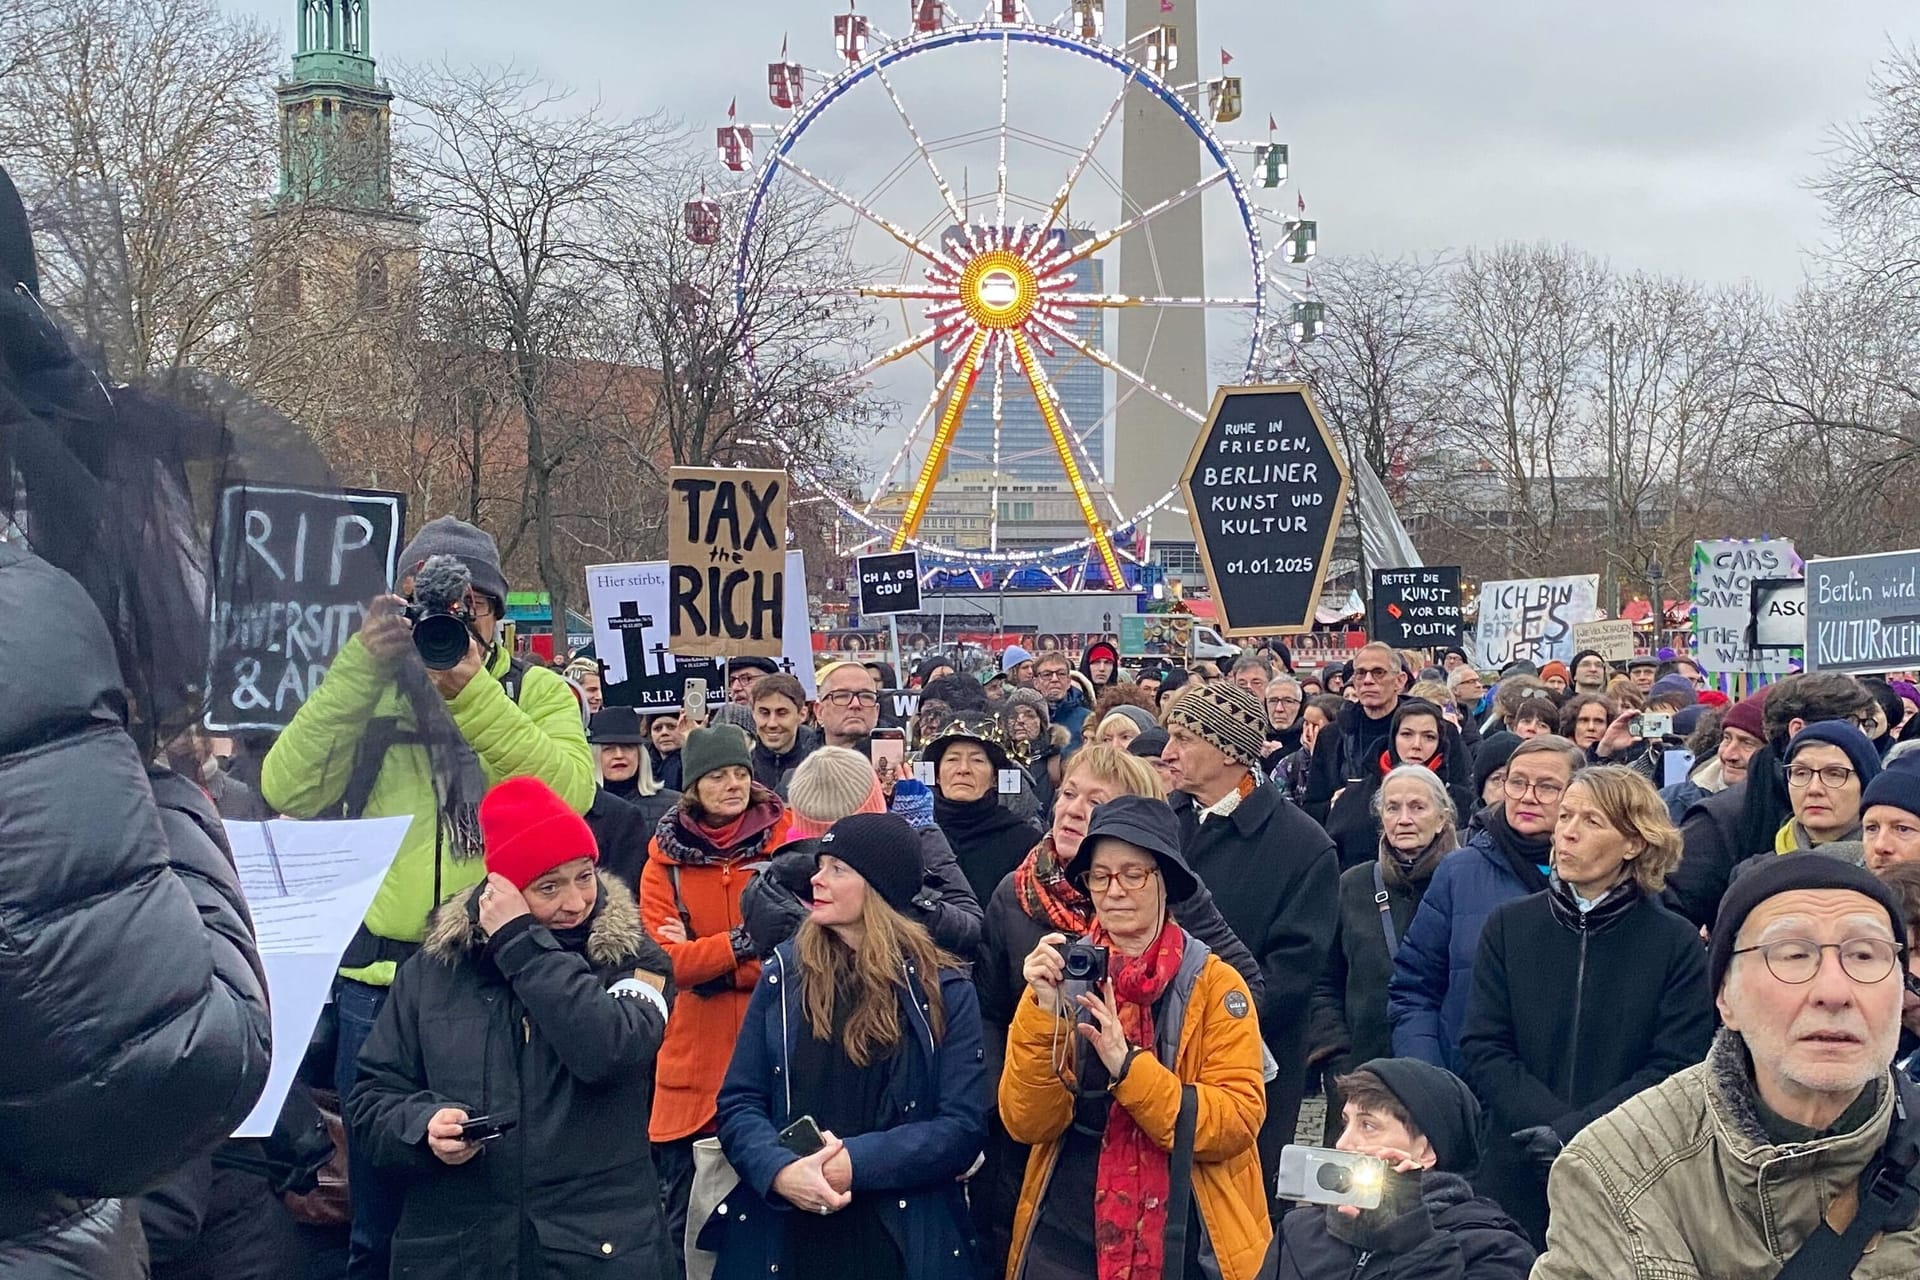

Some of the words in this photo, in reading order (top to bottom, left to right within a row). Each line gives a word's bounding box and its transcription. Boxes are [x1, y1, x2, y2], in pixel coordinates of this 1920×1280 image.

[1225, 423, 1256, 435] RUHE
[1268, 420, 1283, 433] IN
[1220, 437, 1311, 453] FRIEDEN,
[1203, 463, 1318, 486] BERLINER
[1211, 494, 1279, 512] KUNST
[1291, 493, 1323, 507] UND
[672, 479, 779, 551] TAX
[1221, 516, 1308, 535] KULTUR
[709, 546, 744, 565] the
[1713, 549, 1779, 570] CARS
[1227, 557, 1313, 574] 01.01.2025
[597, 576, 625, 588] Hier
[628, 573, 665, 587] stirbt,
[876, 583, 902, 595] CDU
[1381, 574, 1416, 585] RETTET
[1423, 574, 1439, 583] DIE
[1819, 570, 1873, 604] Berlin
[1882, 566, 1916, 598] wird
[669, 565, 782, 640] RICH
[1401, 587, 1451, 602] KUNST
[1494, 585, 1528, 610] ICH
[1538, 584, 1573, 605] BIN
[1696, 587, 1743, 608] SAVE
[1409, 607, 1433, 616] VOR
[1438, 606, 1459, 616] DER
[1401, 623, 1456, 638] POLITIK
[1521, 603, 1569, 643] ES
[1697, 627, 1740, 645] THE
[1487, 639, 1563, 665] WERT
[642, 690, 676, 703] R.I.P.
